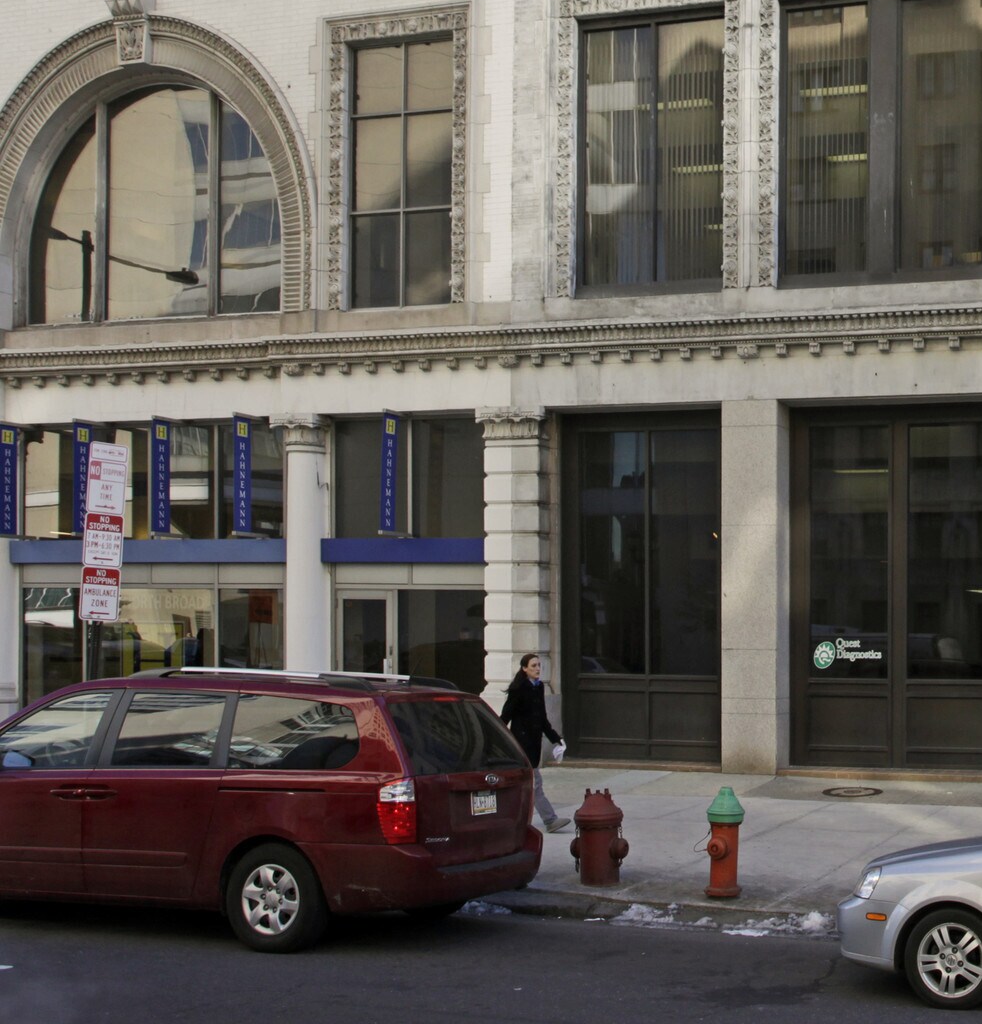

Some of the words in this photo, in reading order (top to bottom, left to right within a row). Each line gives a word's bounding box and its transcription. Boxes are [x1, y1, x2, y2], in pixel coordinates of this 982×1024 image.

[157, 426, 166, 438] H
[238, 423, 247, 436] H
[387, 420, 395, 433] H
[3, 431, 13, 443] H
[79, 429, 88, 441] H
[90, 465, 101, 476] NO
[103, 467, 125, 477] STOPPING
[101, 483, 113, 492] ANY
[385, 438, 393, 527] HAHNEMANN
[100, 493, 113, 501] TIME
[88, 522, 120, 532] STOPPING
[96, 569, 107, 577] NO
[85, 575, 117, 585] STOPPING
[84, 587, 117, 598] AMBULANCE
[91, 599, 108, 608] ZONE
[835, 637, 861, 651] Quest
[836, 649, 882, 662] Diagnostics
